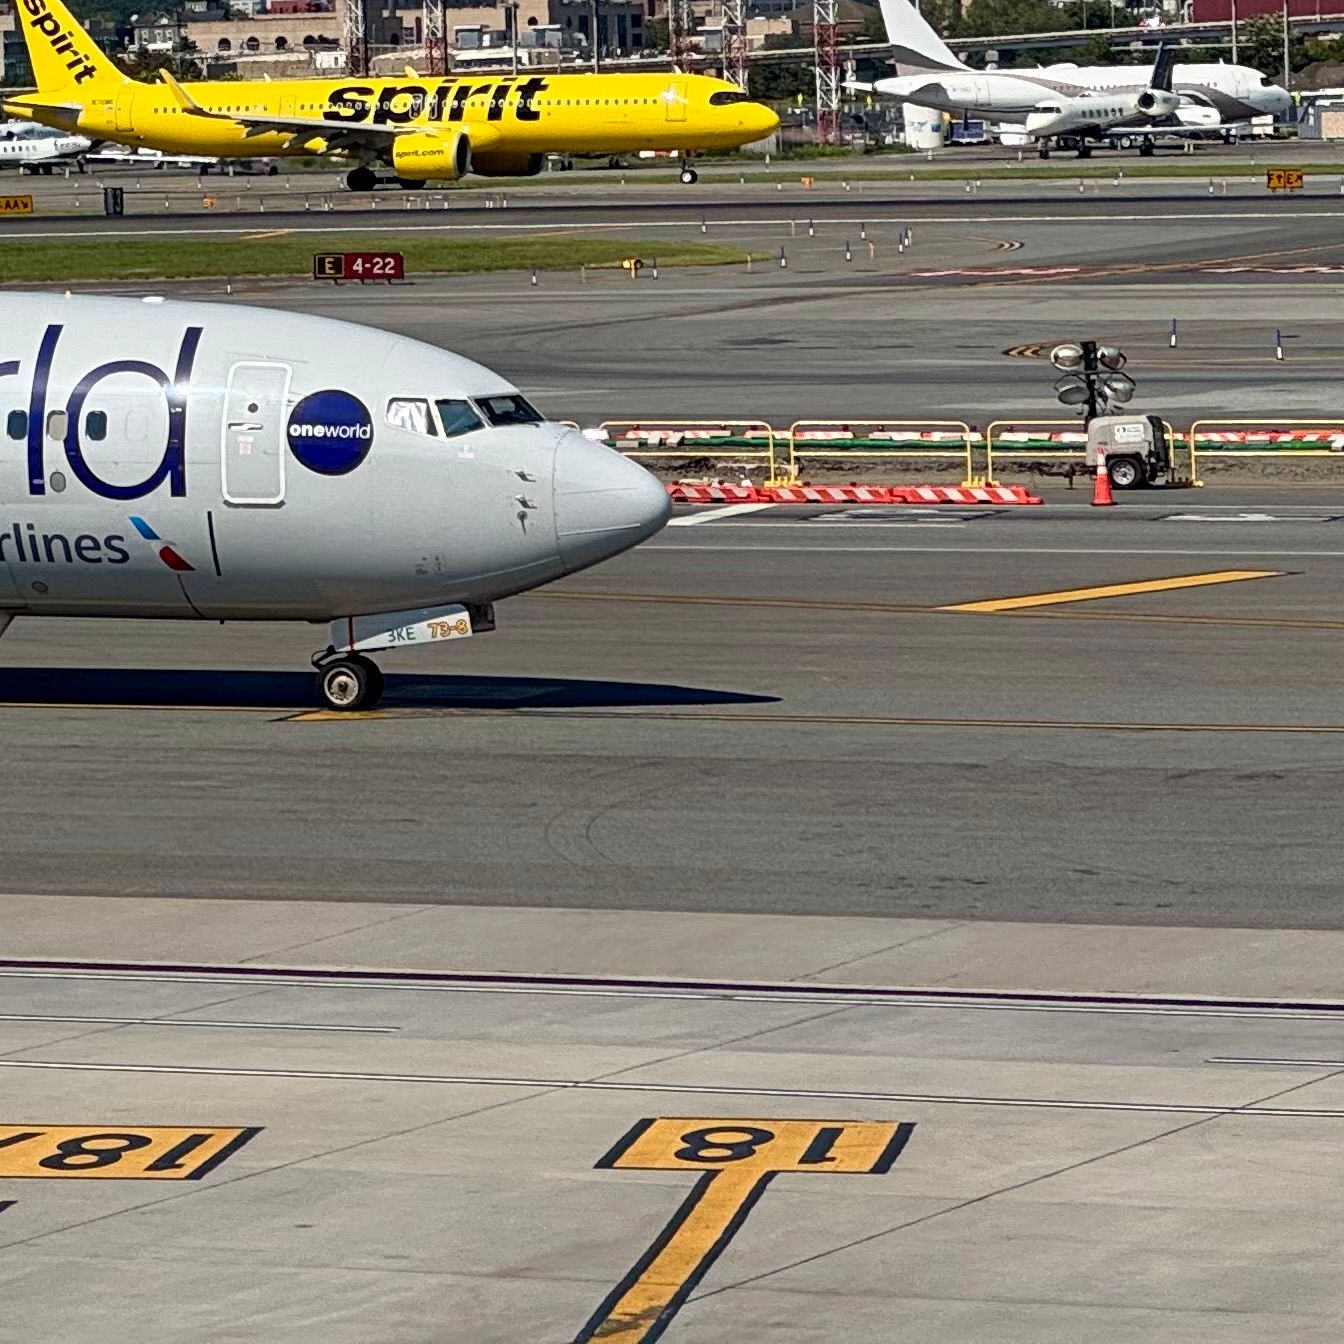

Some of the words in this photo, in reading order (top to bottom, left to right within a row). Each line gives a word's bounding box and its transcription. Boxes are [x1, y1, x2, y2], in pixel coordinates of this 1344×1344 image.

[323, 77, 550, 124] spirit
[5, 199, 20, 210] AA
[325, 258, 335, 274] E
[352, 257, 395, 274] 4-22
[289, 422, 371, 439] oneworld
[387, 626, 416, 643] 3KE
[427, 619, 469, 639] 73-8
[674, 1126, 845, 1164] 18
